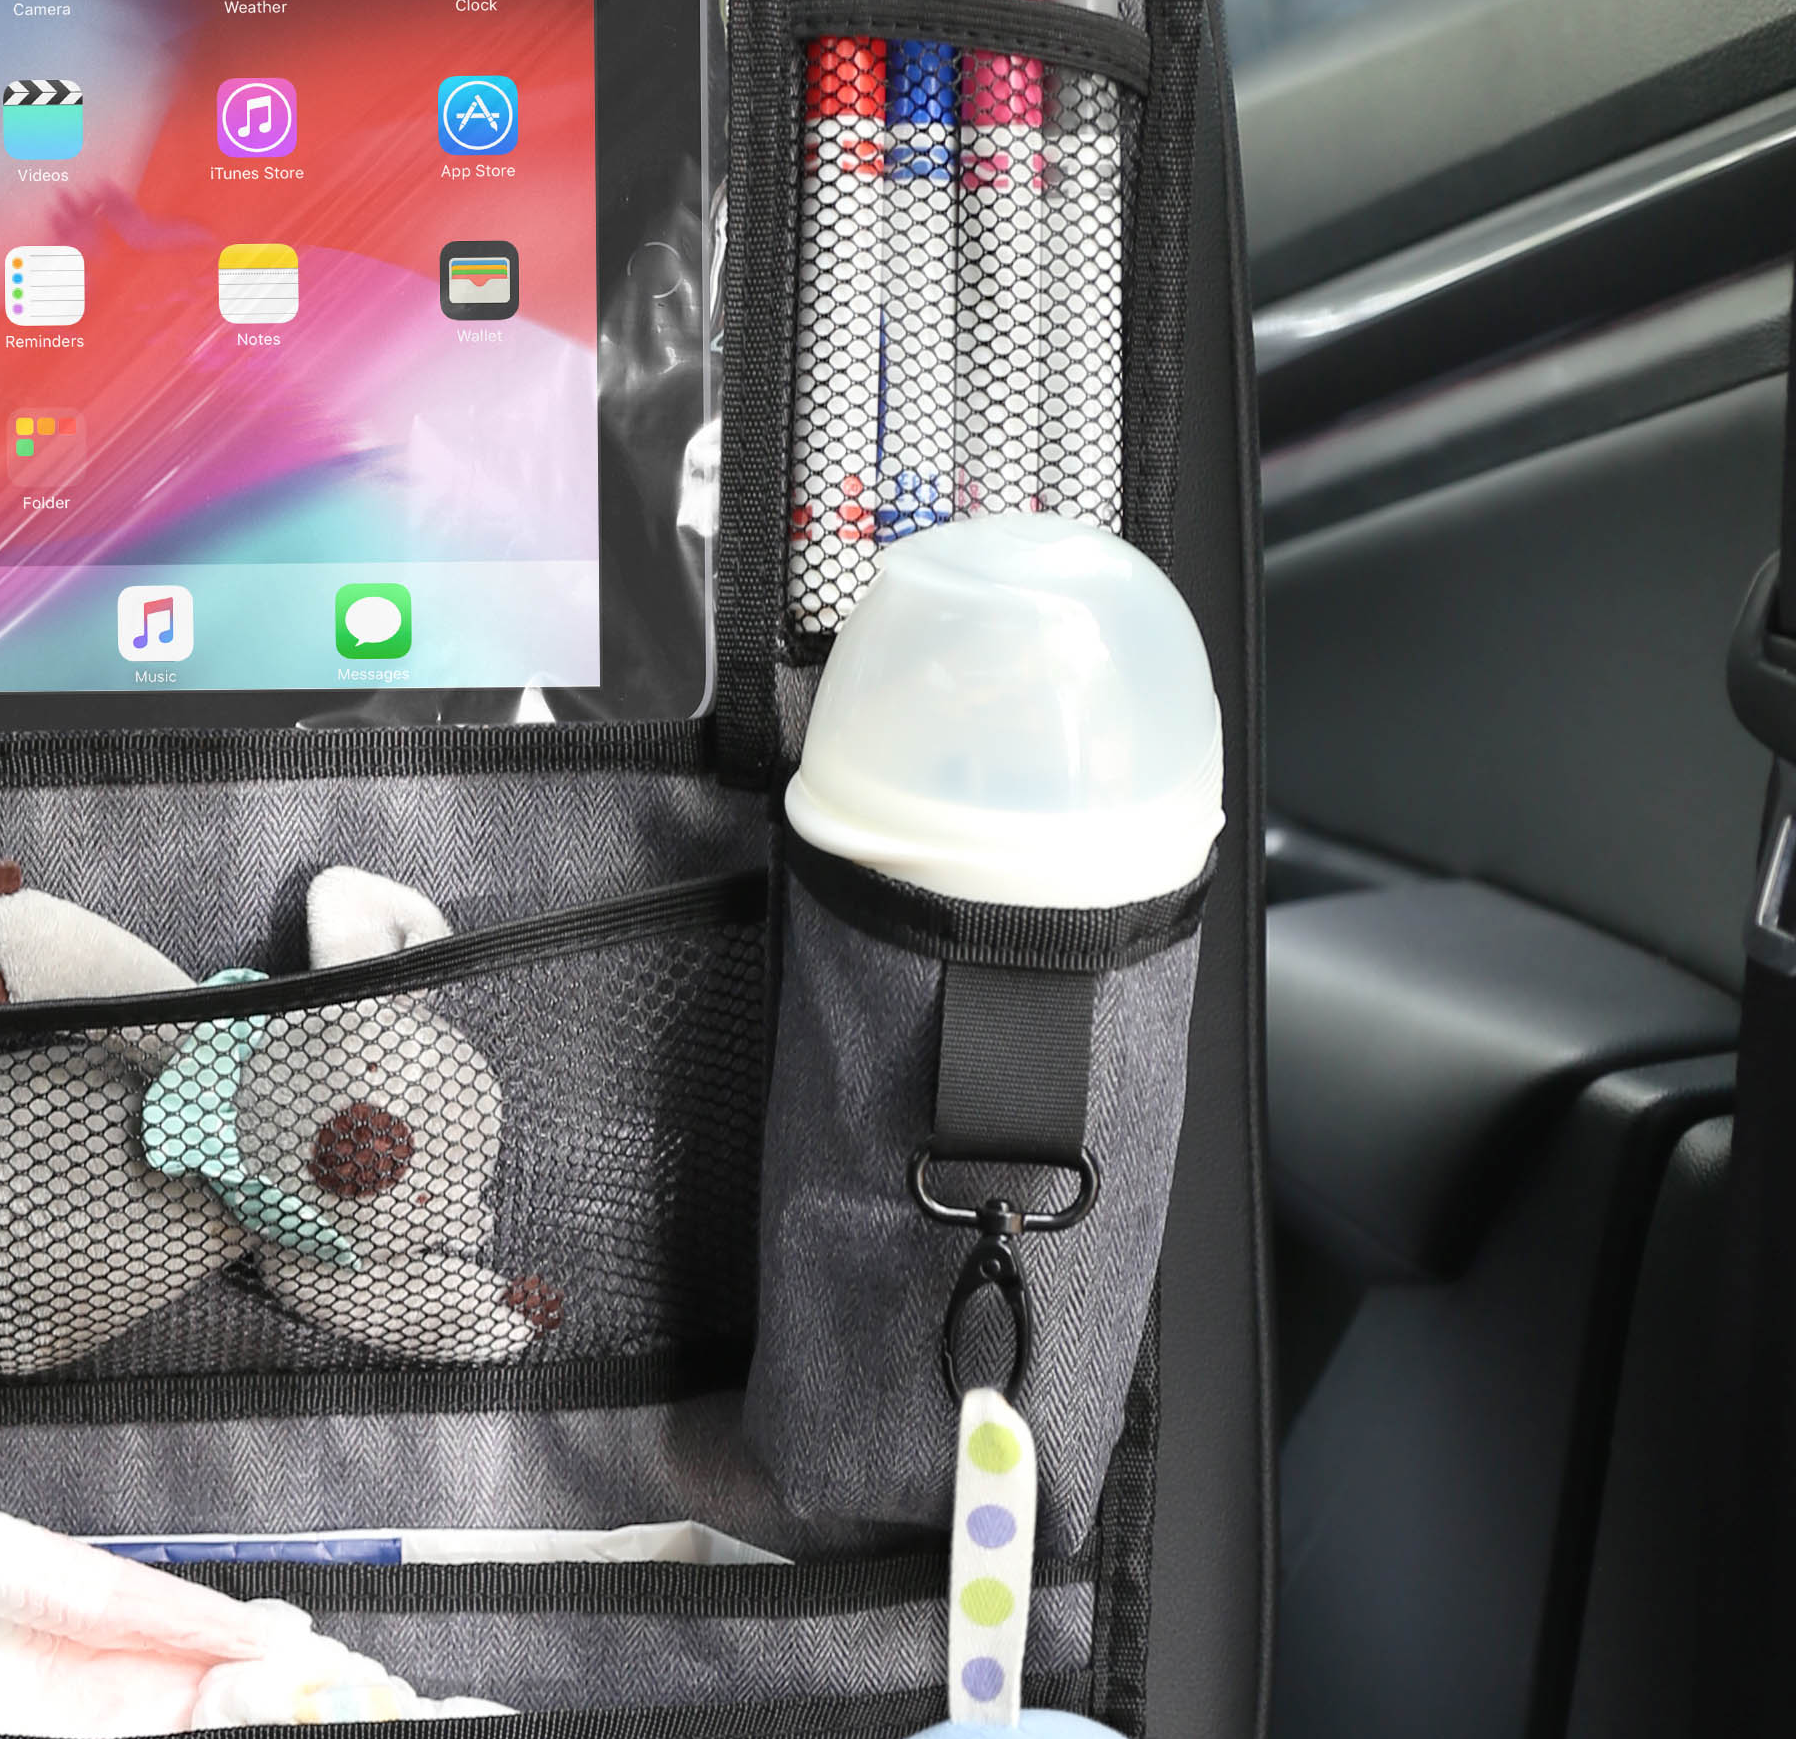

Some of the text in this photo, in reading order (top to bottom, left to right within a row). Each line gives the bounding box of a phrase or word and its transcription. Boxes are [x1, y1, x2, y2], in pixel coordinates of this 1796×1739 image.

[13, 3, 71, 16] Camera
[224, 1, 288, 14] Weather
[17, 168, 69, 182] Videos
[210, 167, 304, 180] iTunes Store
[440, 165, 516, 181] App Store
[5, 335, 84, 348] Reminders
[237, 333, 281, 346] Notes
[456, 329, 502, 343] Wallet
[22, 497, 70, 510] Folder
[134, 670, 176, 683] Music
[338, 668, 410, 685] Messages
